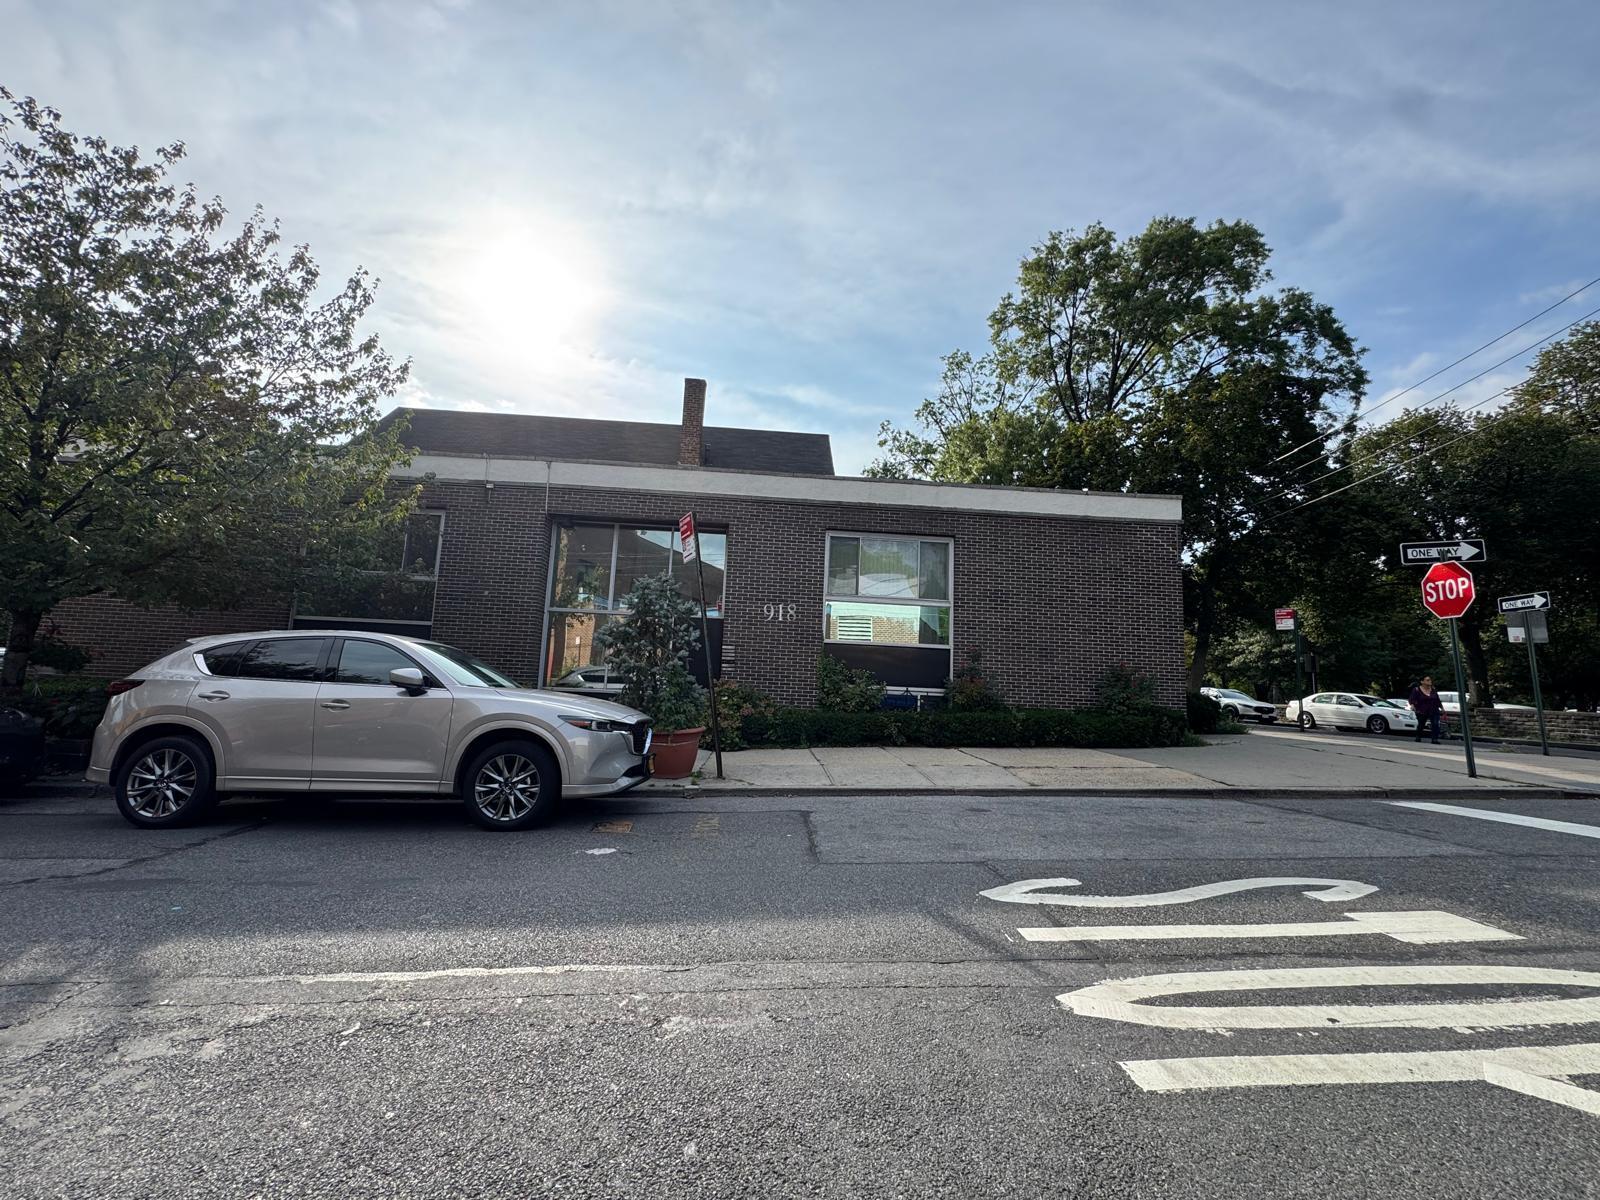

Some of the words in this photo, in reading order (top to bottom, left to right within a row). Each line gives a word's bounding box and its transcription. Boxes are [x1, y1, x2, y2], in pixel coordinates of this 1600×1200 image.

[1411, 549, 1433, 557] ONE
[1426, 577, 1469, 602] STOP
[764, 603, 796, 621] 918
